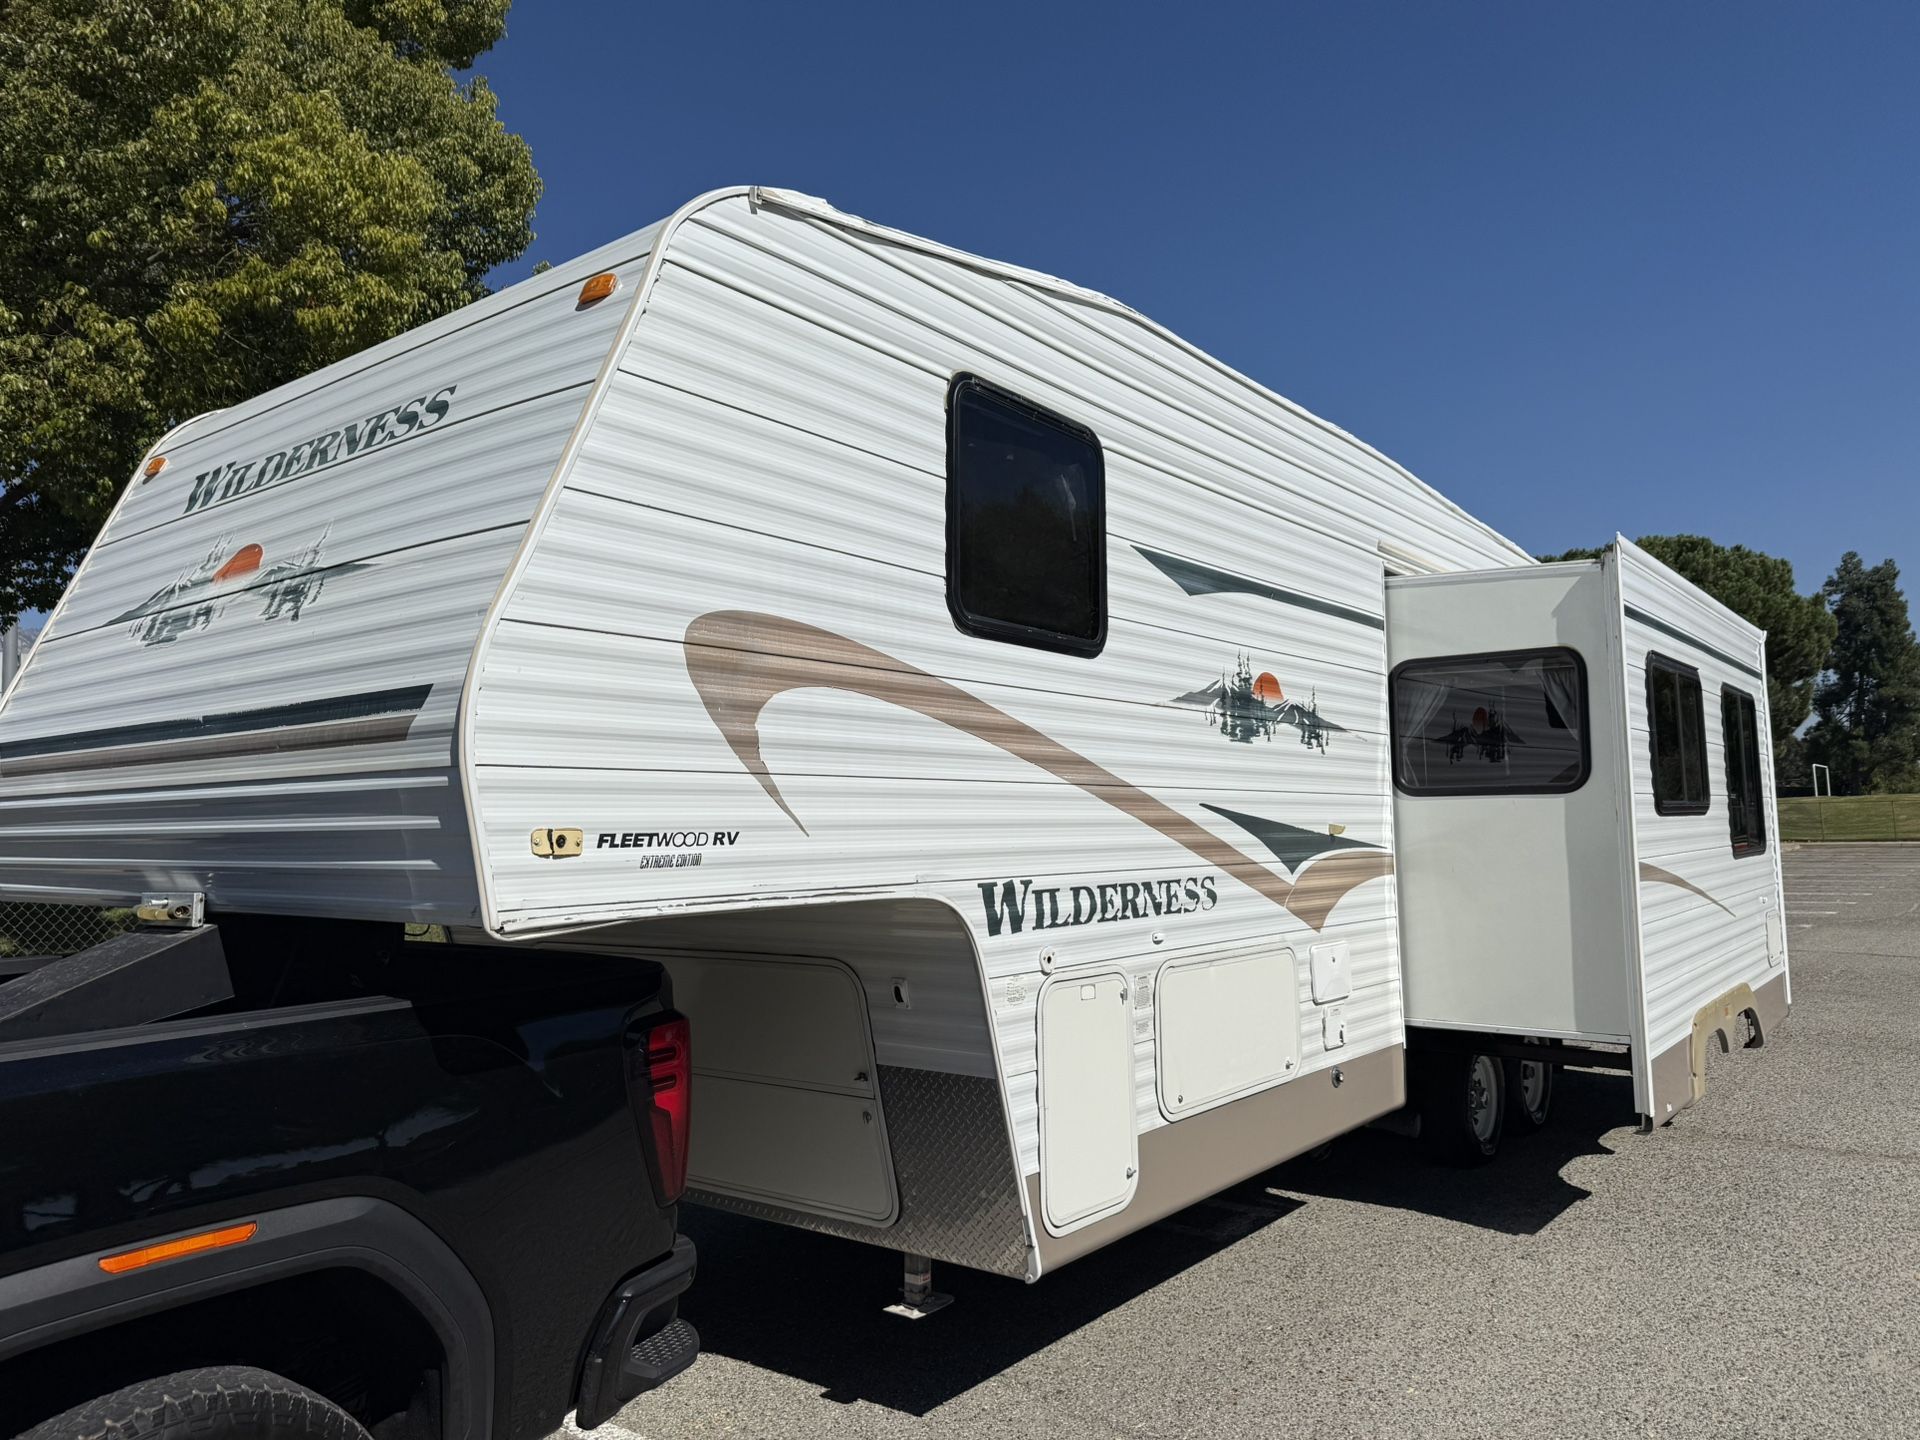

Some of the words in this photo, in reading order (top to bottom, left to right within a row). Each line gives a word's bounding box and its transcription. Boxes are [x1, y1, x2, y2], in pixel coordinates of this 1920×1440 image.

[183, 384, 458, 515] WILDERNESS
[597, 831, 709, 849] FLEETWOOD
[712, 831, 740, 846] RV
[639, 854, 676, 870] EXTREME
[675, 853, 702, 868] EDITION
[977, 876, 1218, 937] WILDERNESS
